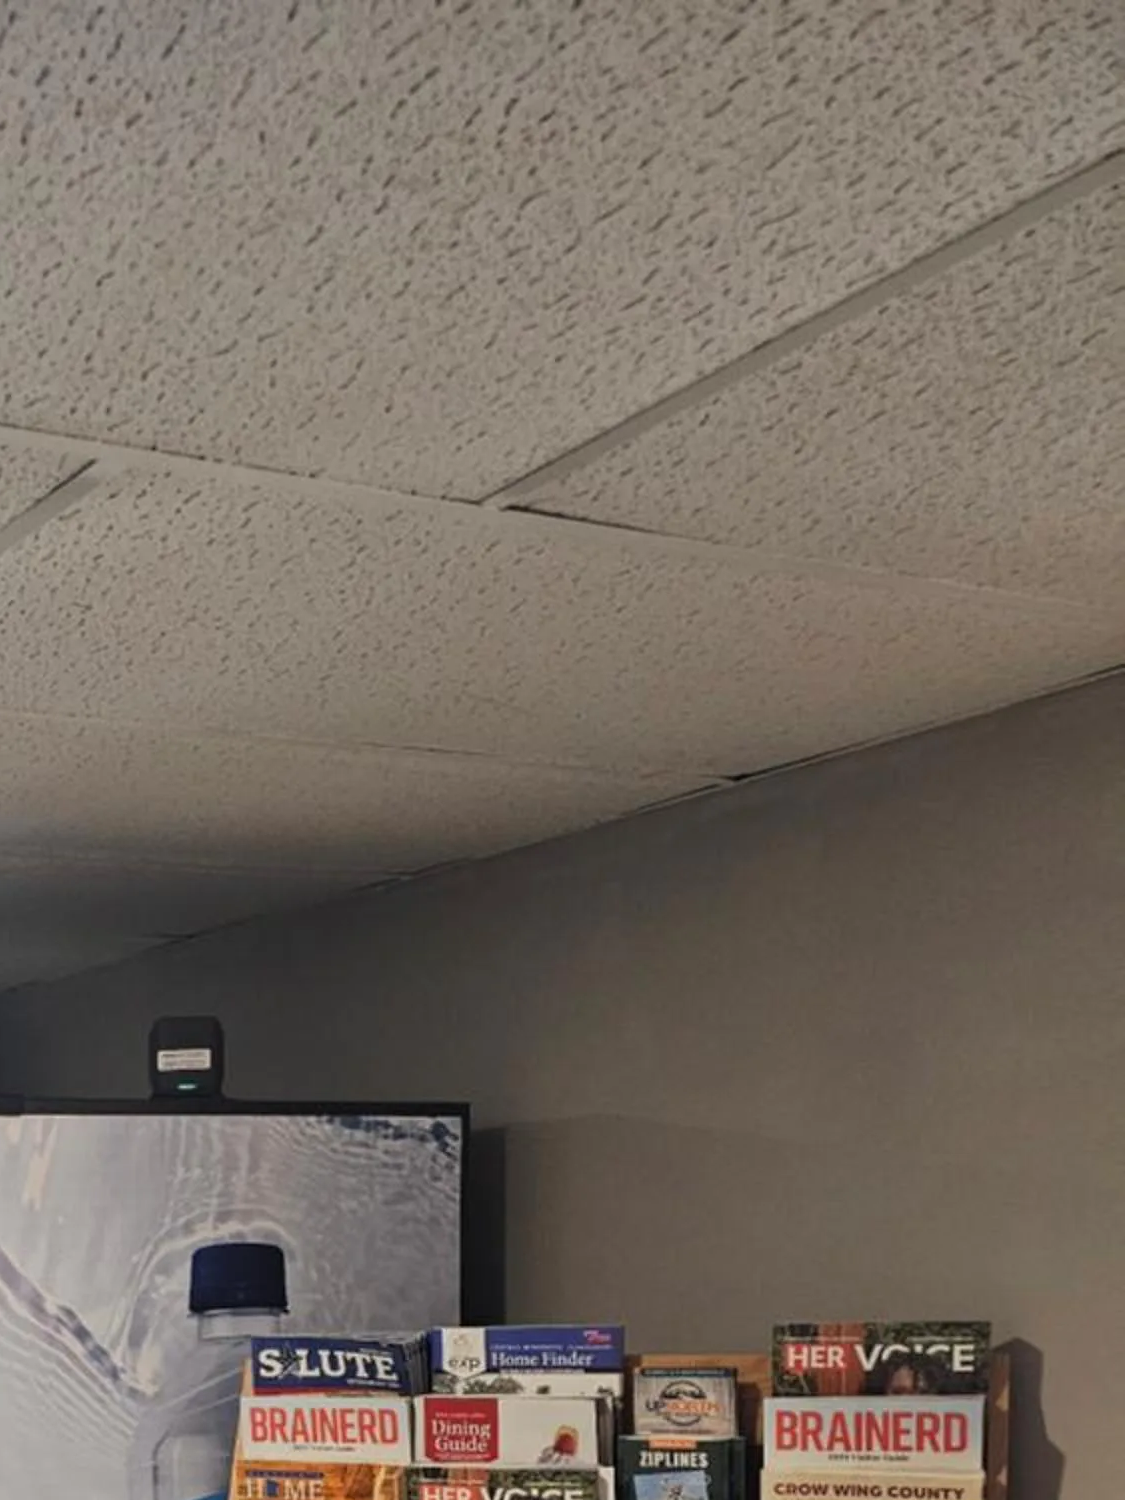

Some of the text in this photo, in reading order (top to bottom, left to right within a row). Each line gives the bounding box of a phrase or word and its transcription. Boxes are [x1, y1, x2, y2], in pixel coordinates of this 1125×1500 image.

[258, 1347, 399, 1382] SLUTE
[491, 1348, 594, 1367] Home Finder
[787, 1343, 975, 1372] HER VOCE
[250, 1406, 399, 1444] BRAINERD
[431, 1419, 492, 1440] Dining
[775, 1409, 969, 1453] BRAINERD
[434, 1436, 488, 1452] Guide
[639, 1451, 709, 1468] ZIPLINES
[245, 1478, 323, 1500] HME
[774, 1482, 966, 1500] CROW WING COUNTY
